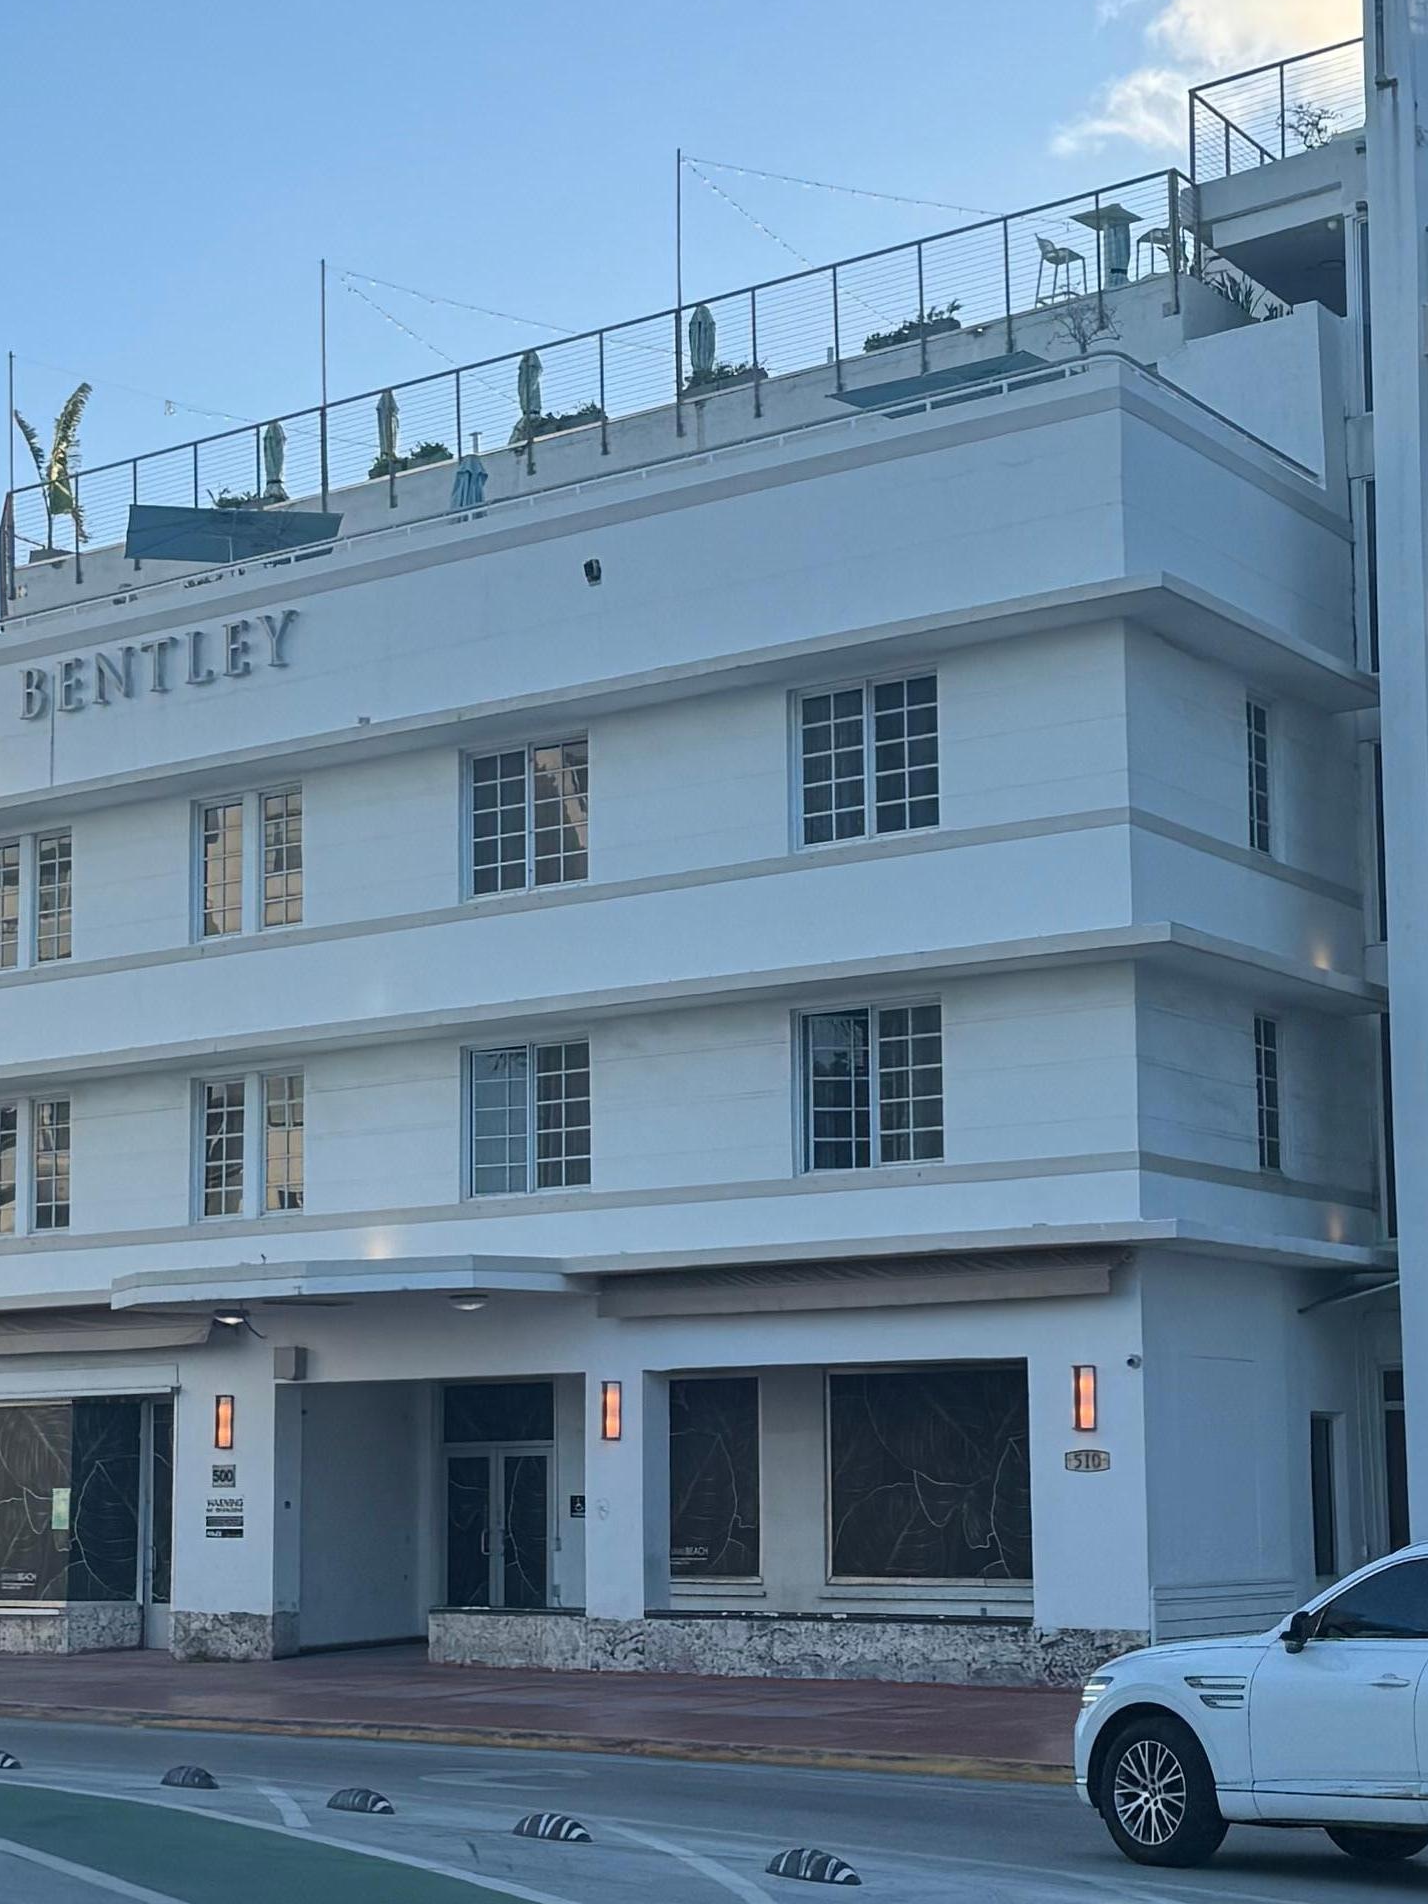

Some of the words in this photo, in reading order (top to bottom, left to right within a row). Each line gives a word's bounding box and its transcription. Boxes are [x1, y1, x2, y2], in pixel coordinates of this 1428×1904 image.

[19, 609, 300, 721] BENTLEY
[1074, 1453, 1101, 1469] 510
[212, 1469, 233, 1482] 500
